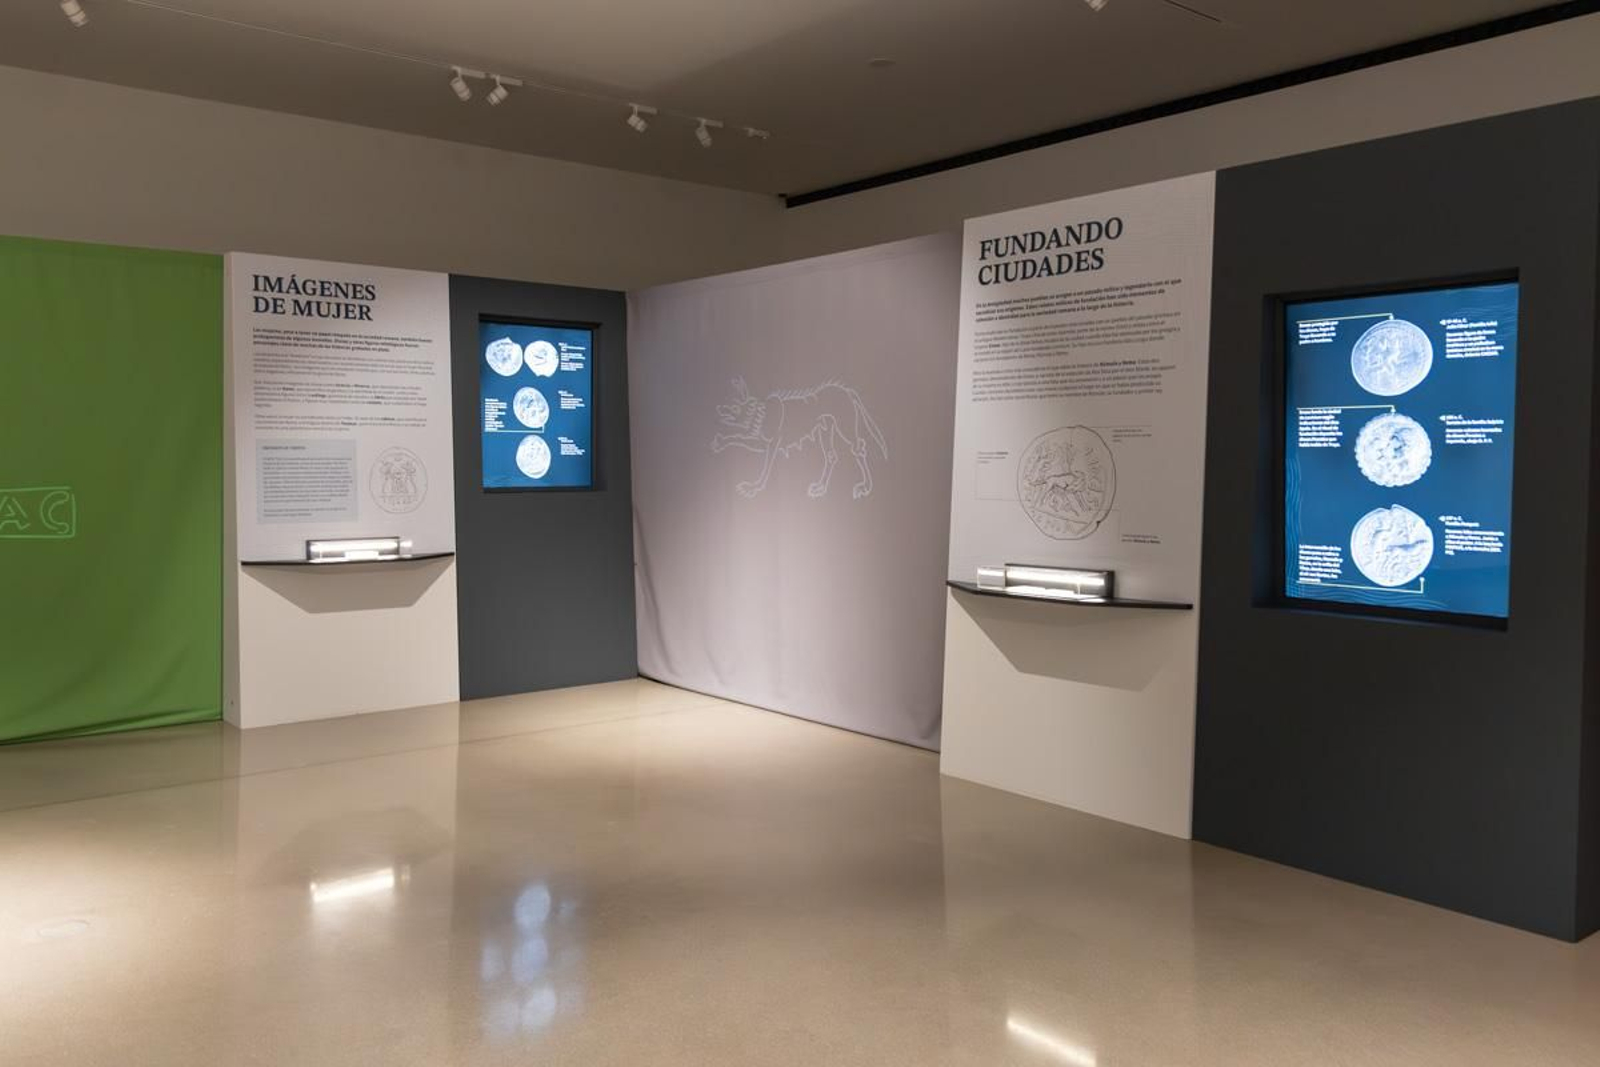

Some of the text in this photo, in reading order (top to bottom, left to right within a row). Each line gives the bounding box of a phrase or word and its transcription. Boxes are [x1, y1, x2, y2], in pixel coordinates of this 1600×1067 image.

[979, 216, 1124, 261] FUNDANDO
[978, 247, 1105, 286] CIUDADES
[252, 274, 376, 301] IMÁGENES
[253, 295, 373, 321] DE MUJER
